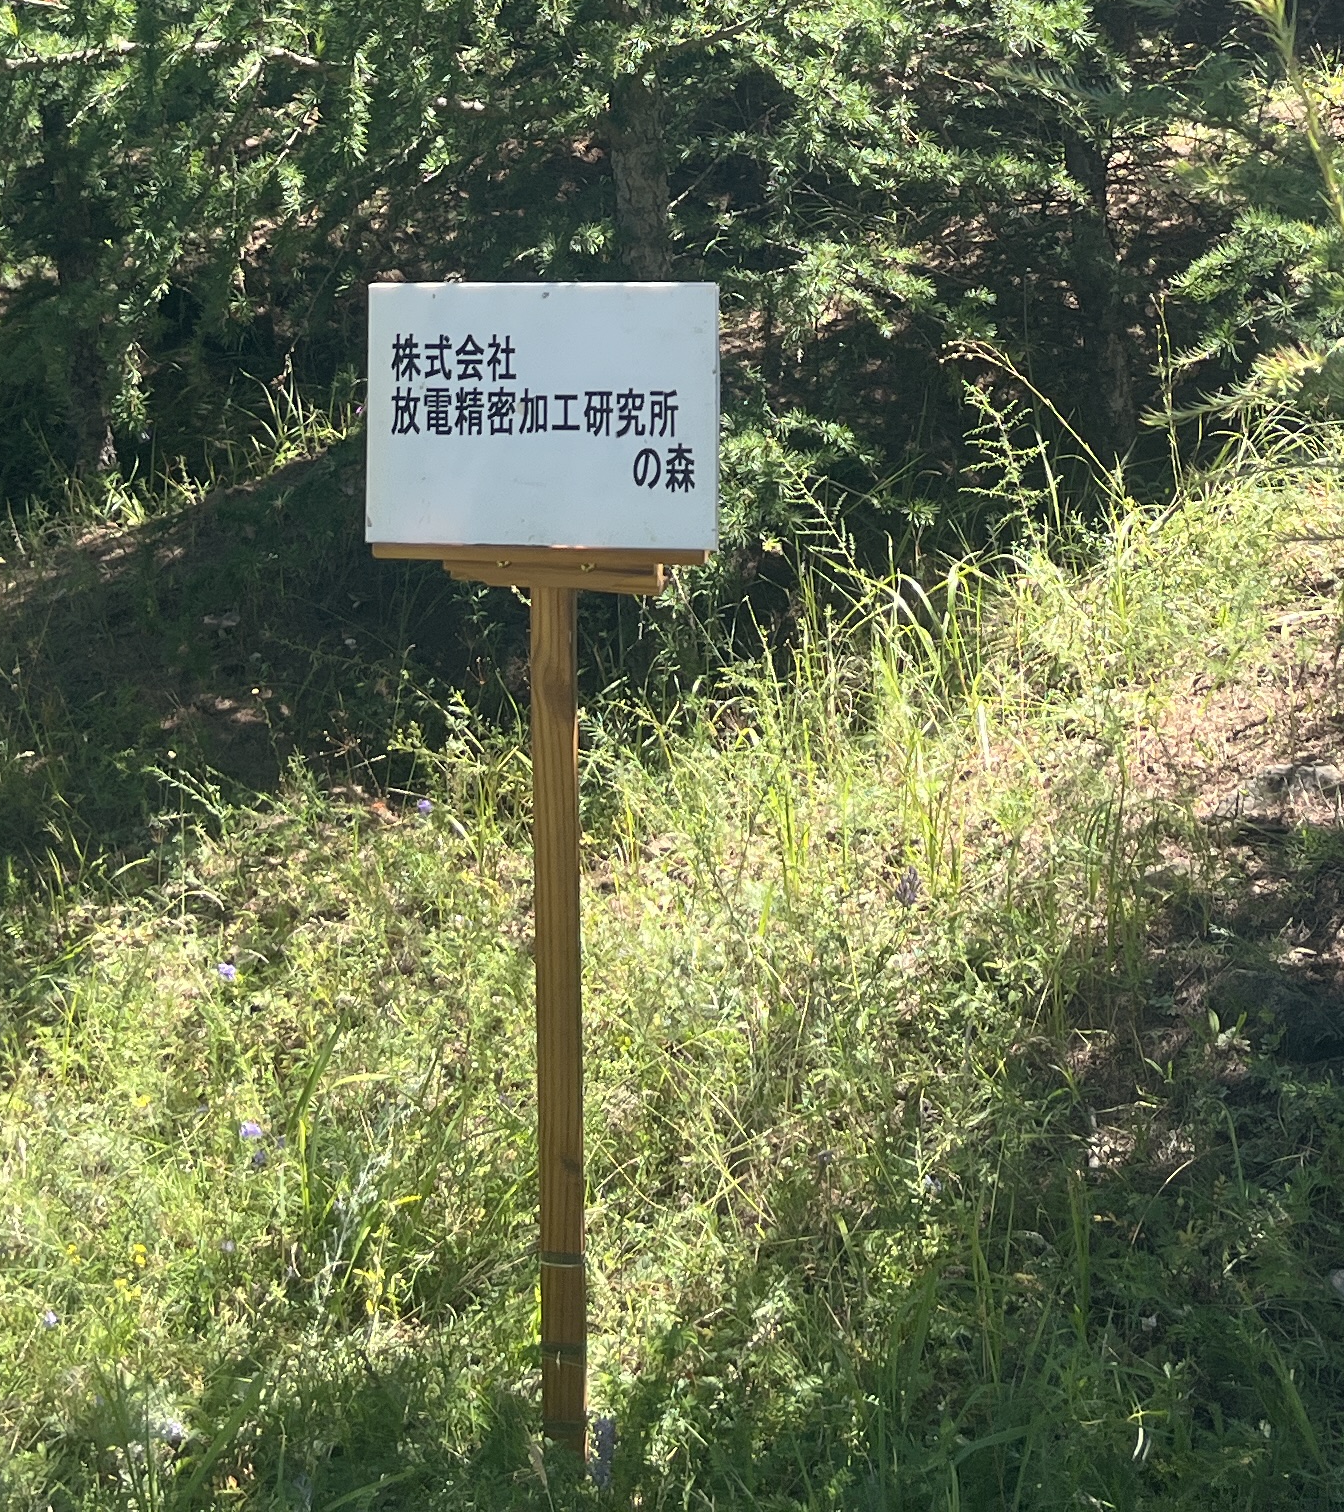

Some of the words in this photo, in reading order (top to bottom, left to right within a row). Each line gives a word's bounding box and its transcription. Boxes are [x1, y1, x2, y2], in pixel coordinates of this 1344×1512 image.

[391, 333, 517, 382] 株式会社
[391, 387, 679, 438] 放電精密加工研究所
[633, 443, 696, 493] の森
